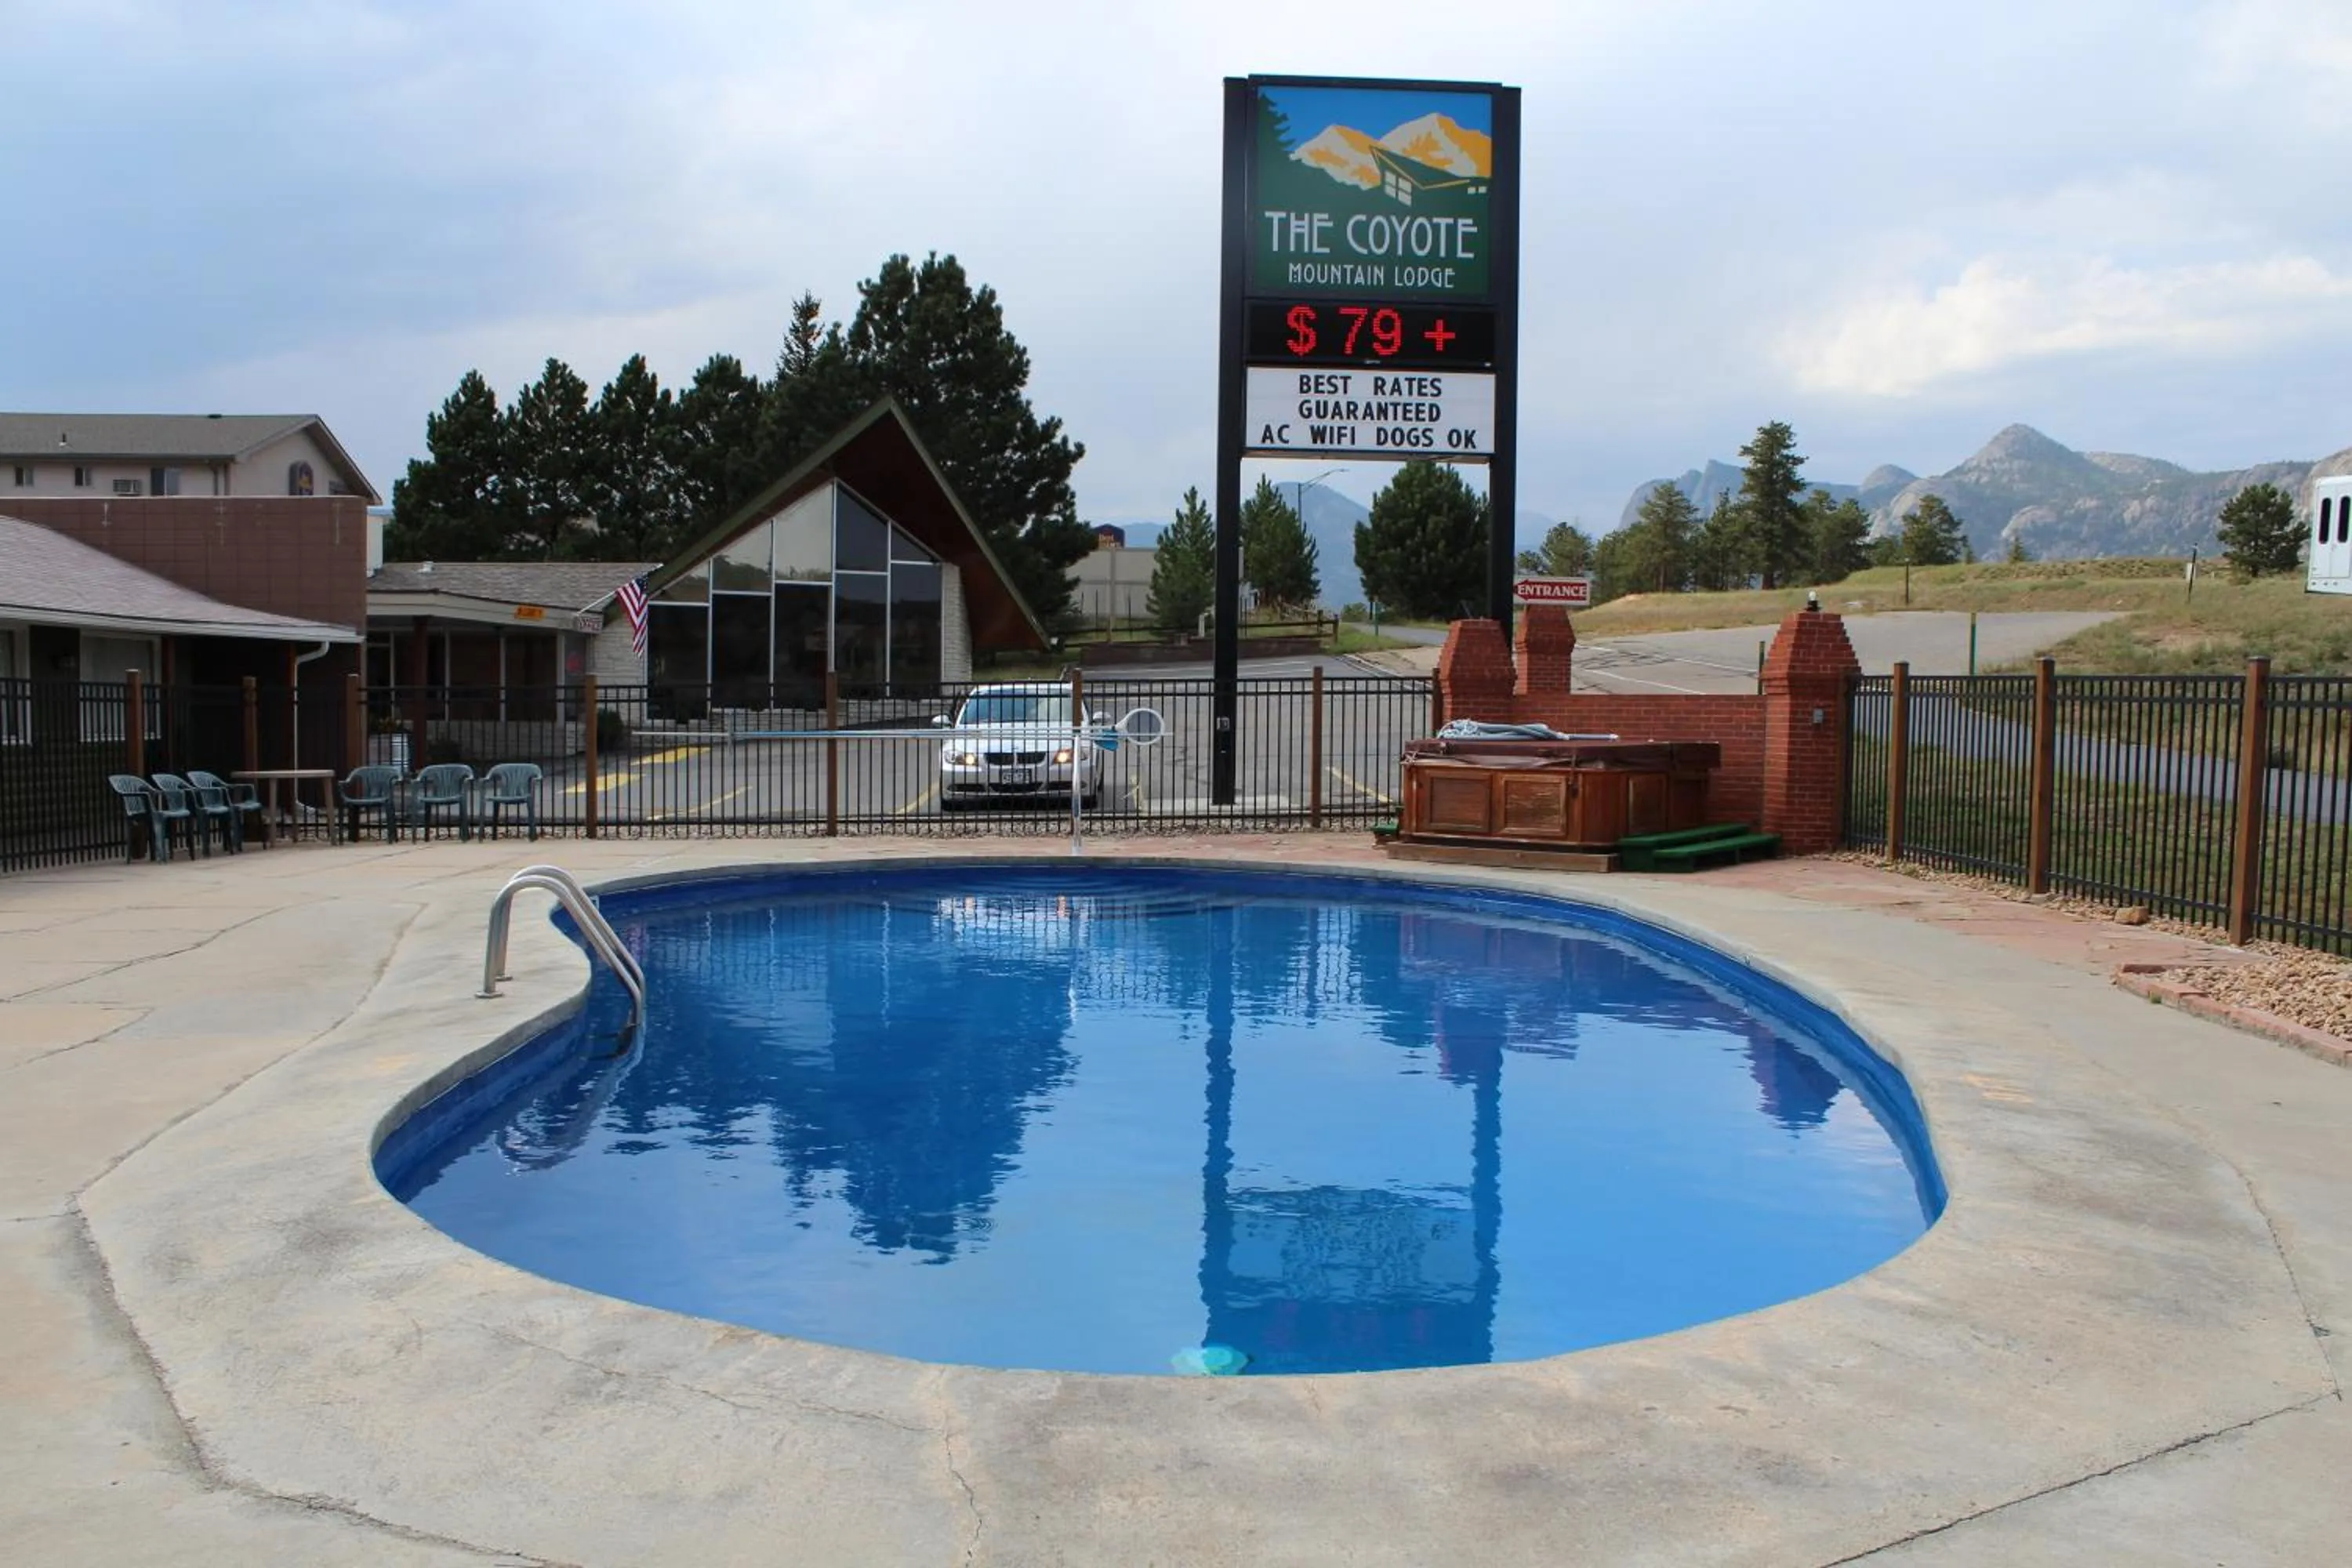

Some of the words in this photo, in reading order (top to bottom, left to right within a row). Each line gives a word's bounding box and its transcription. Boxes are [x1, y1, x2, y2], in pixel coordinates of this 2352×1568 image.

[1264, 211, 1333, 253] THE
[1346, 213, 1478, 259] COYOTE
[1288, 262, 1385, 287] MOUNTAIN
[1394, 266, 1456, 288] LODGE
[1287, 303, 1317, 356] $
[1338, 307, 1403, 355] 79
[1299, 373, 1352, 394] BEST
[1374, 376, 1442, 397] RATES
[1298, 399, 1442, 423] GUARANTEED
[1261, 424, 1290, 445] AC
[1309, 425, 1356, 445] WIFI
[1376, 427, 1434, 448] DOGS
[1447, 429, 1476, 449] OK
[1518, 583, 1586, 597] ENTRANCE
